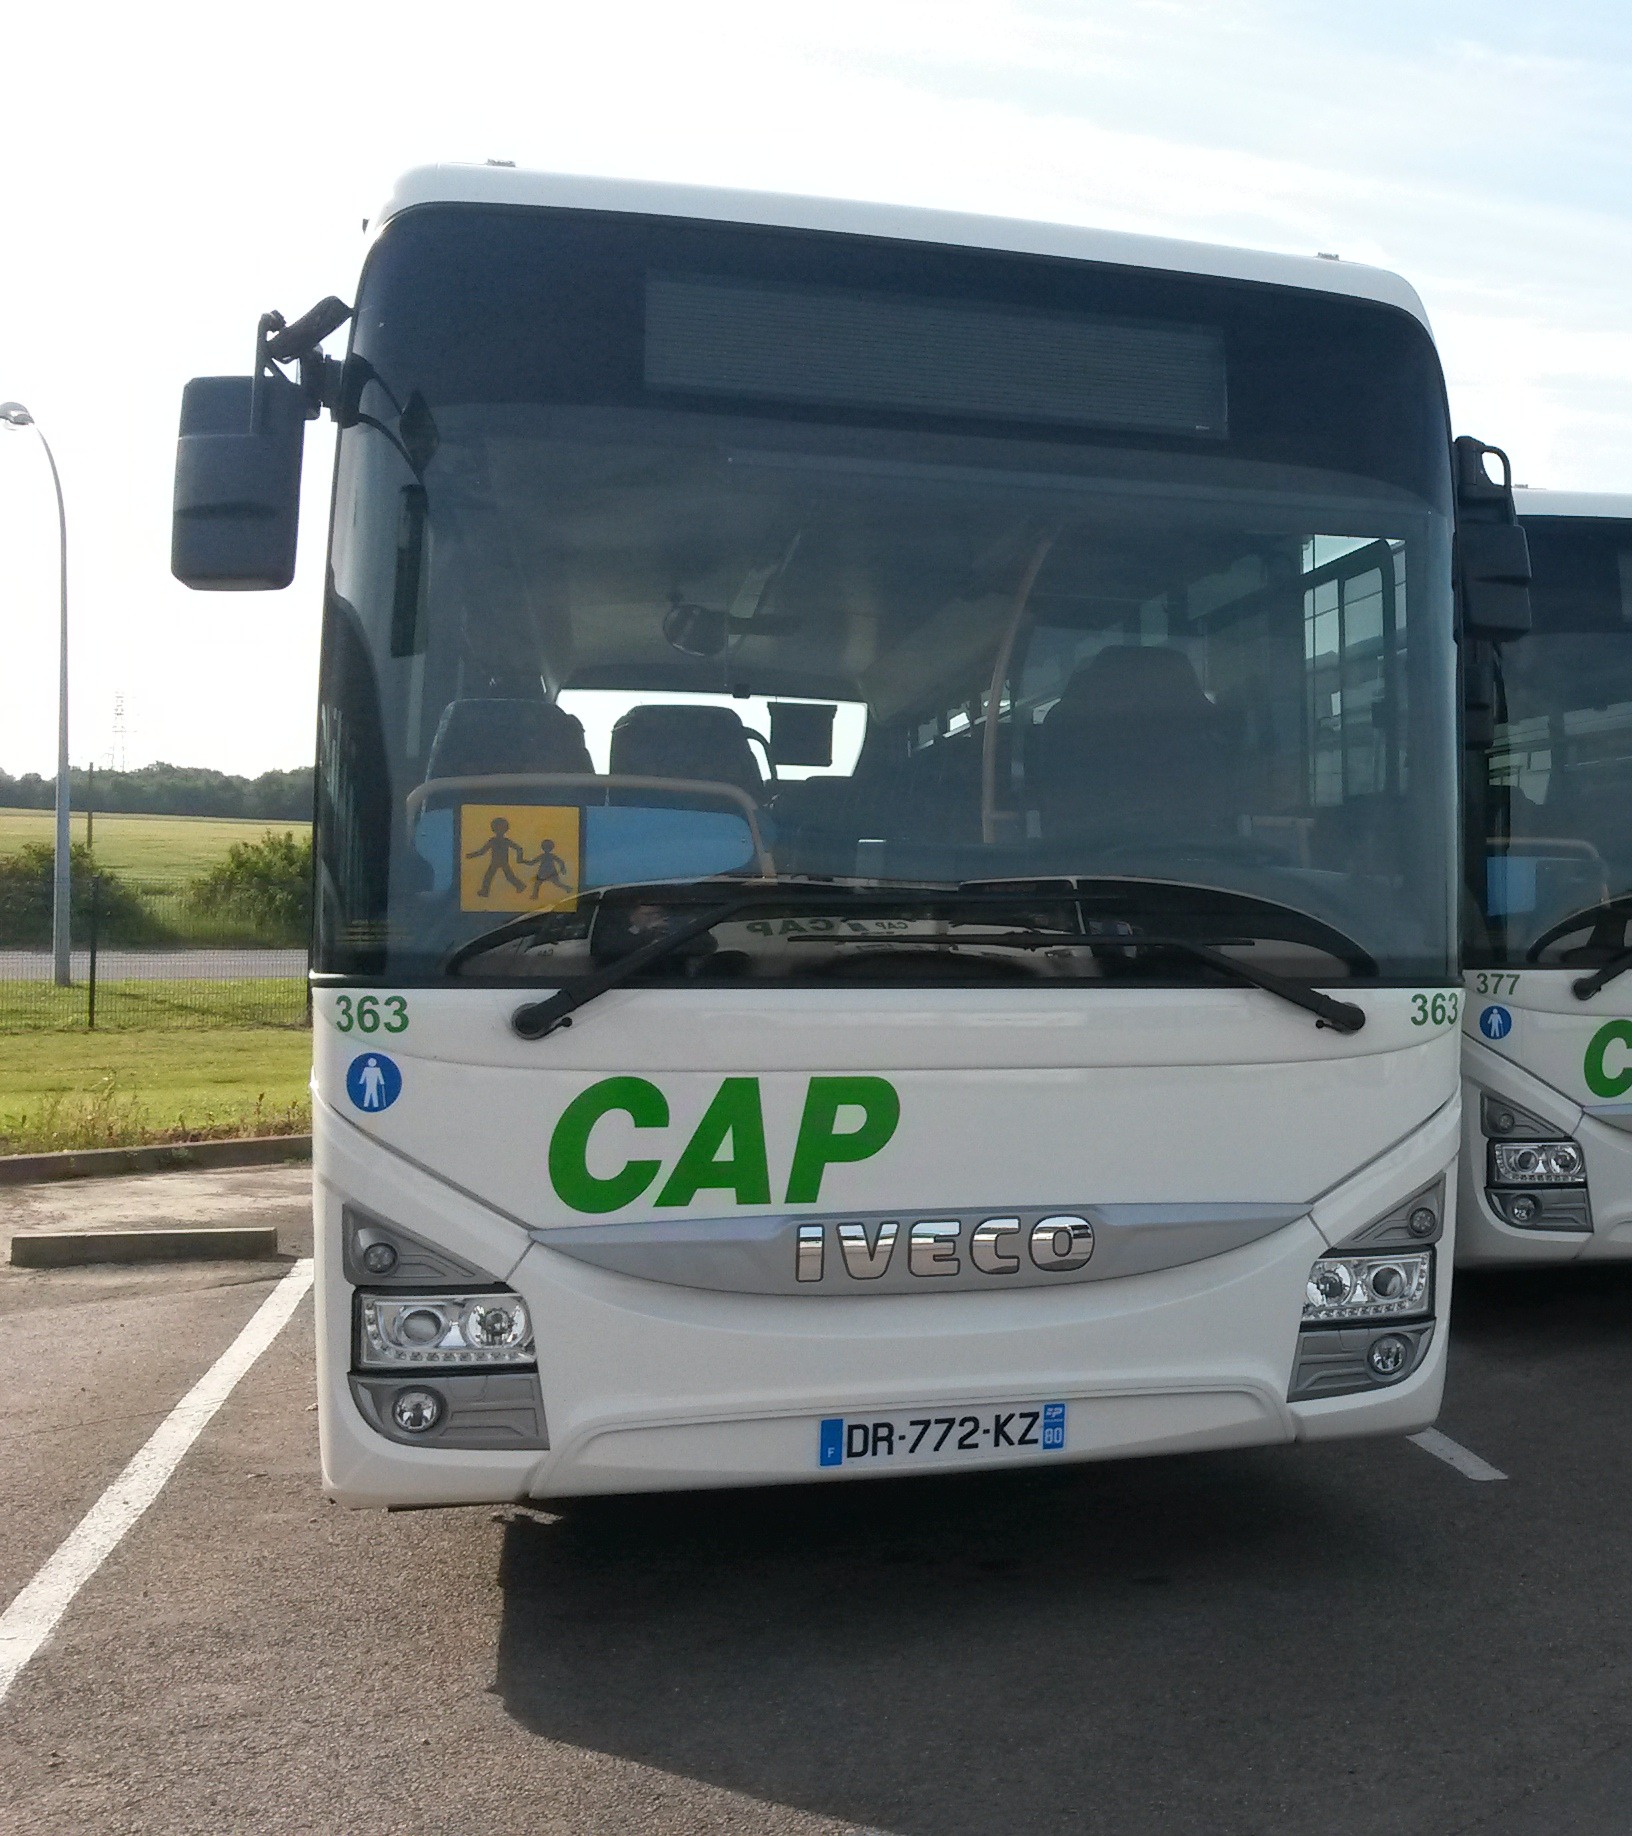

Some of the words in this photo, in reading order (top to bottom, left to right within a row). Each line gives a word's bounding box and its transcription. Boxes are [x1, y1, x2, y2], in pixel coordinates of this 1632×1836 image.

[1476, 973, 1520, 995] 377
[335, 995, 410, 1033] 363
[1410, 993, 1459, 1026] 363
[548, 1075, 901, 1214] CAP
[795, 1213, 1095, 1283] IVECO
[827, 1447, 835, 1458] F
[846, 1411, 1040, 1458] DR-772-KZ
[1044, 1427, 1063, 1445] 80
